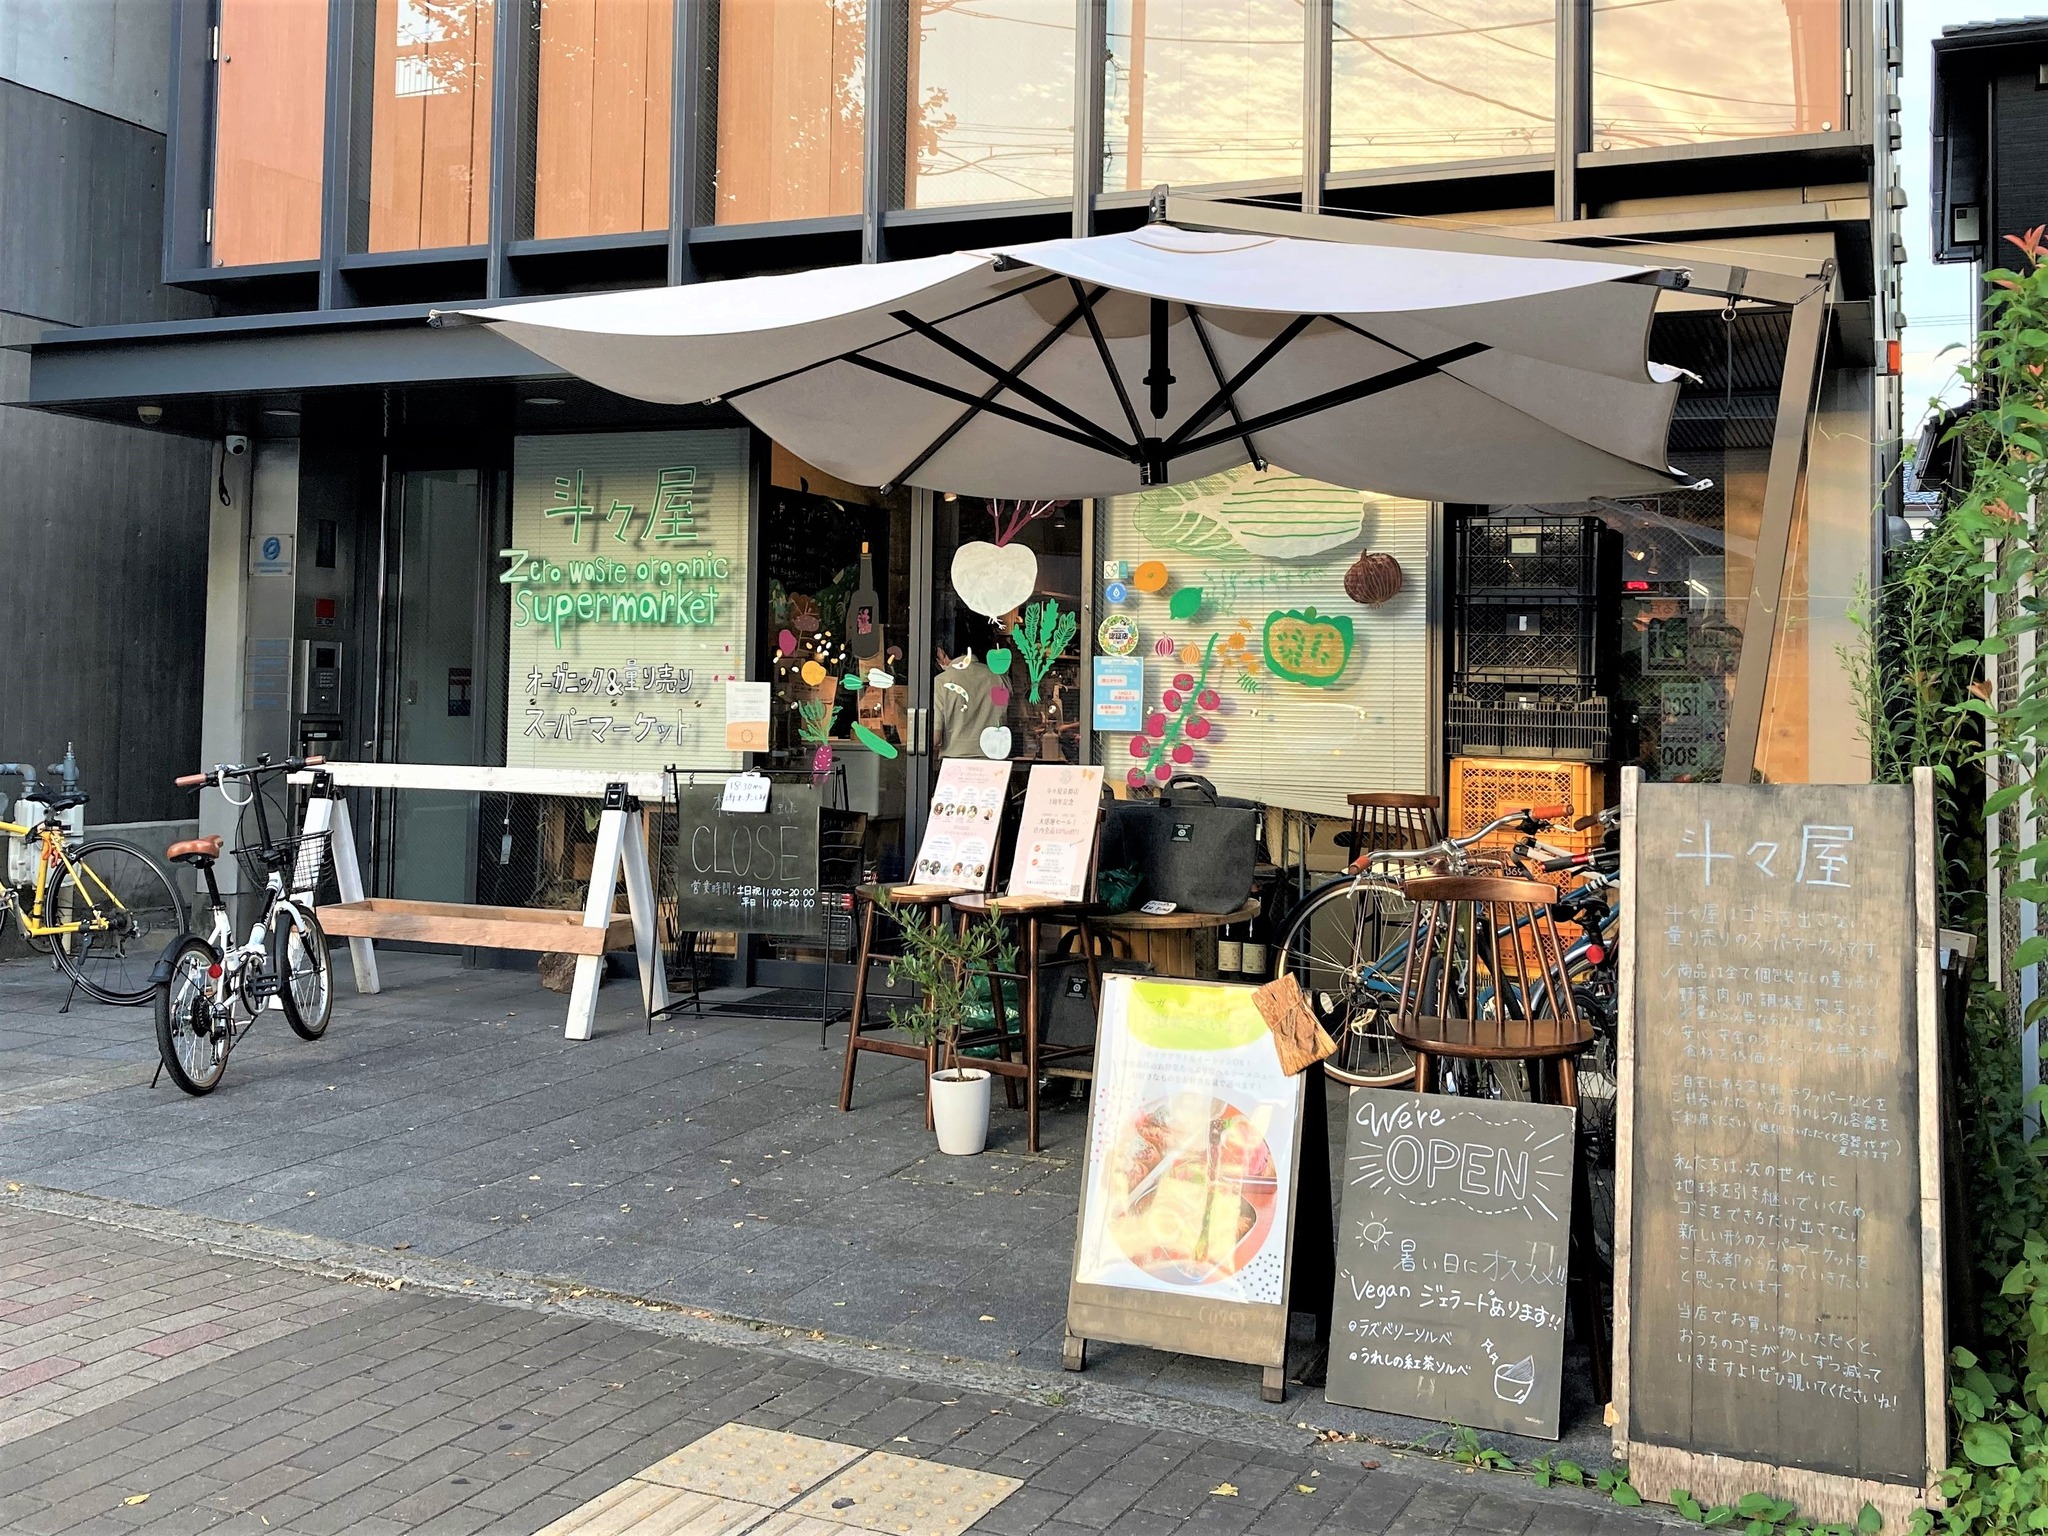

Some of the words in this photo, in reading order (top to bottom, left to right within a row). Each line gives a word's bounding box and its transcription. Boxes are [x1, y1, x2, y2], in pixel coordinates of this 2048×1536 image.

[545, 466, 698, 543] 斗々屋
[499, 550, 561, 583] Zero
[636, 551, 729, 586] organic
[514, 579, 719, 650] Supermarket
[524, 707, 692, 745] スーパーマーケット
[691, 825, 801, 880] CLOSE
[1675, 820, 1854, 888] 斗々屋
[1355, 1099, 1446, 1137] We're
[1386, 1134, 1529, 1200] OPEN
